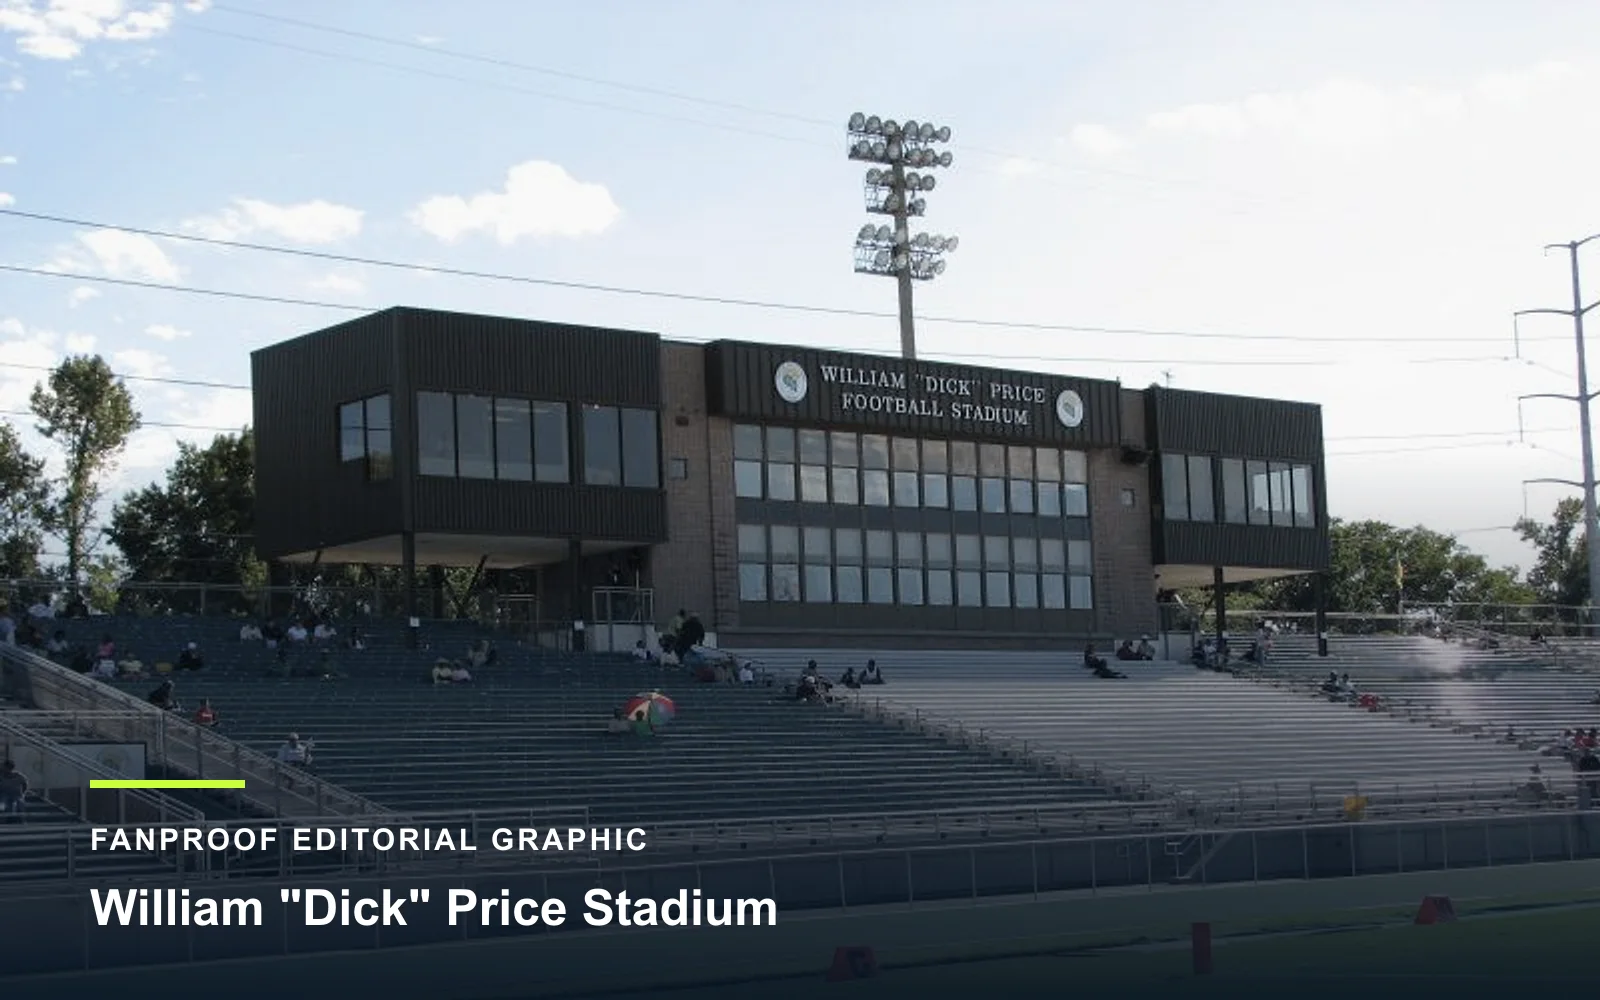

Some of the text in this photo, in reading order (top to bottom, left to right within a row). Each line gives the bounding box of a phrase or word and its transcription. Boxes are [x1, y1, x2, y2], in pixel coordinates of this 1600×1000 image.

[820, 365, 906, 389] WILLIAM
[915, 373, 981, 396] "DICK"
[990, 382, 1046, 403] PRICE
[842, 392, 943, 417] FOOTBALL
[951, 402, 1029, 426] STADIUM
